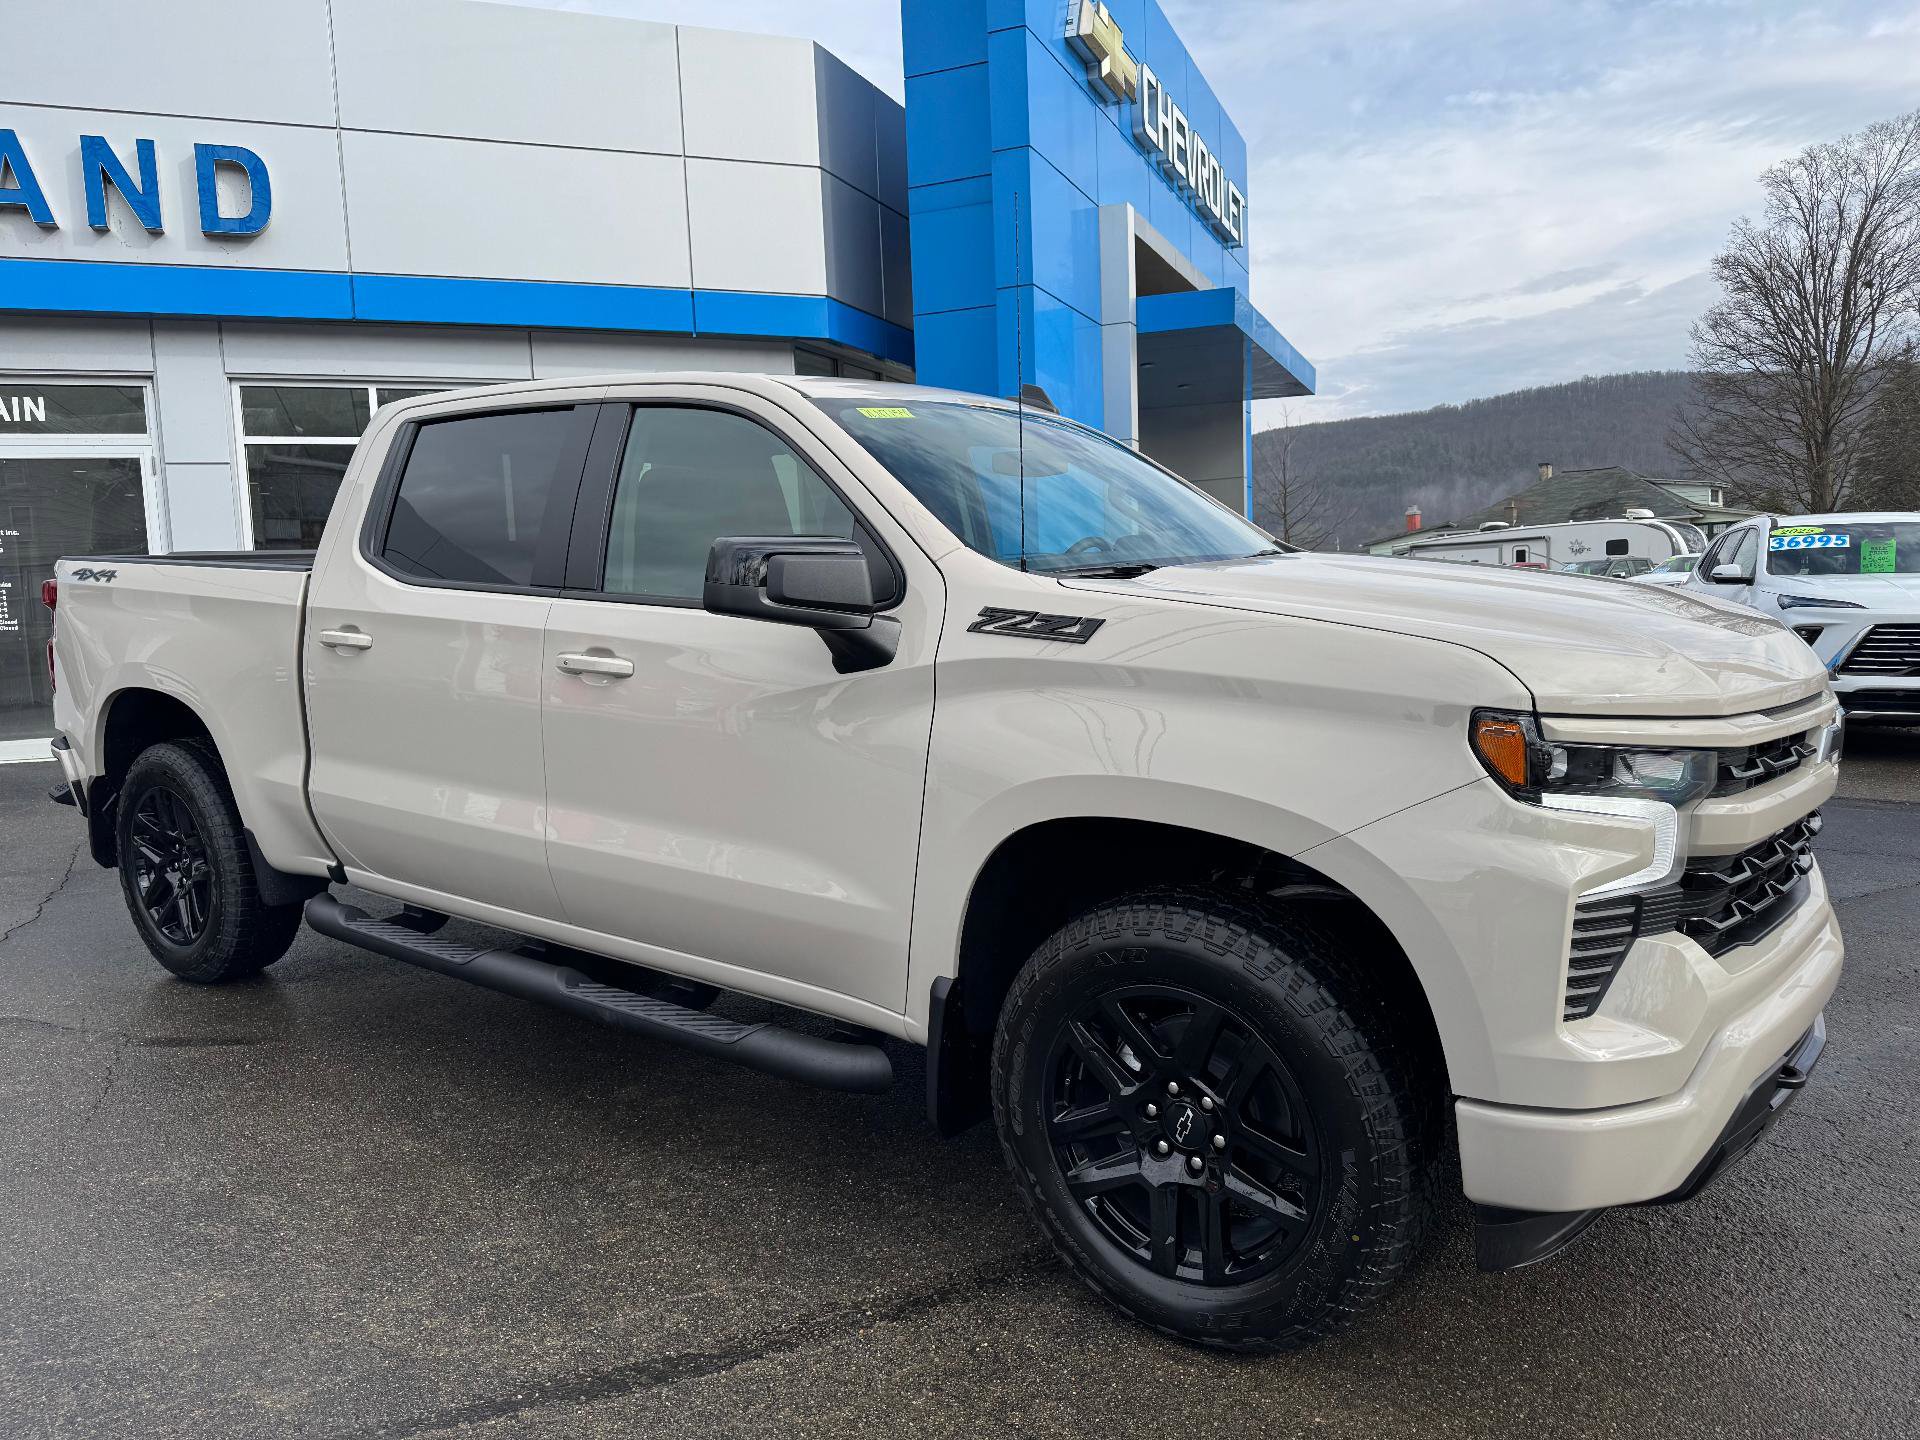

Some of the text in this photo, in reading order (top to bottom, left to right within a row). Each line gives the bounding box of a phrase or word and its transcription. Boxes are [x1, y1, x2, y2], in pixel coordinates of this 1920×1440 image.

[0, 128, 272, 236] AND
[1142, 62, 1246, 248] CHEVROLET
[1770, 535, 1849, 550] 36995
[966, 606, 1107, 645] Z71
